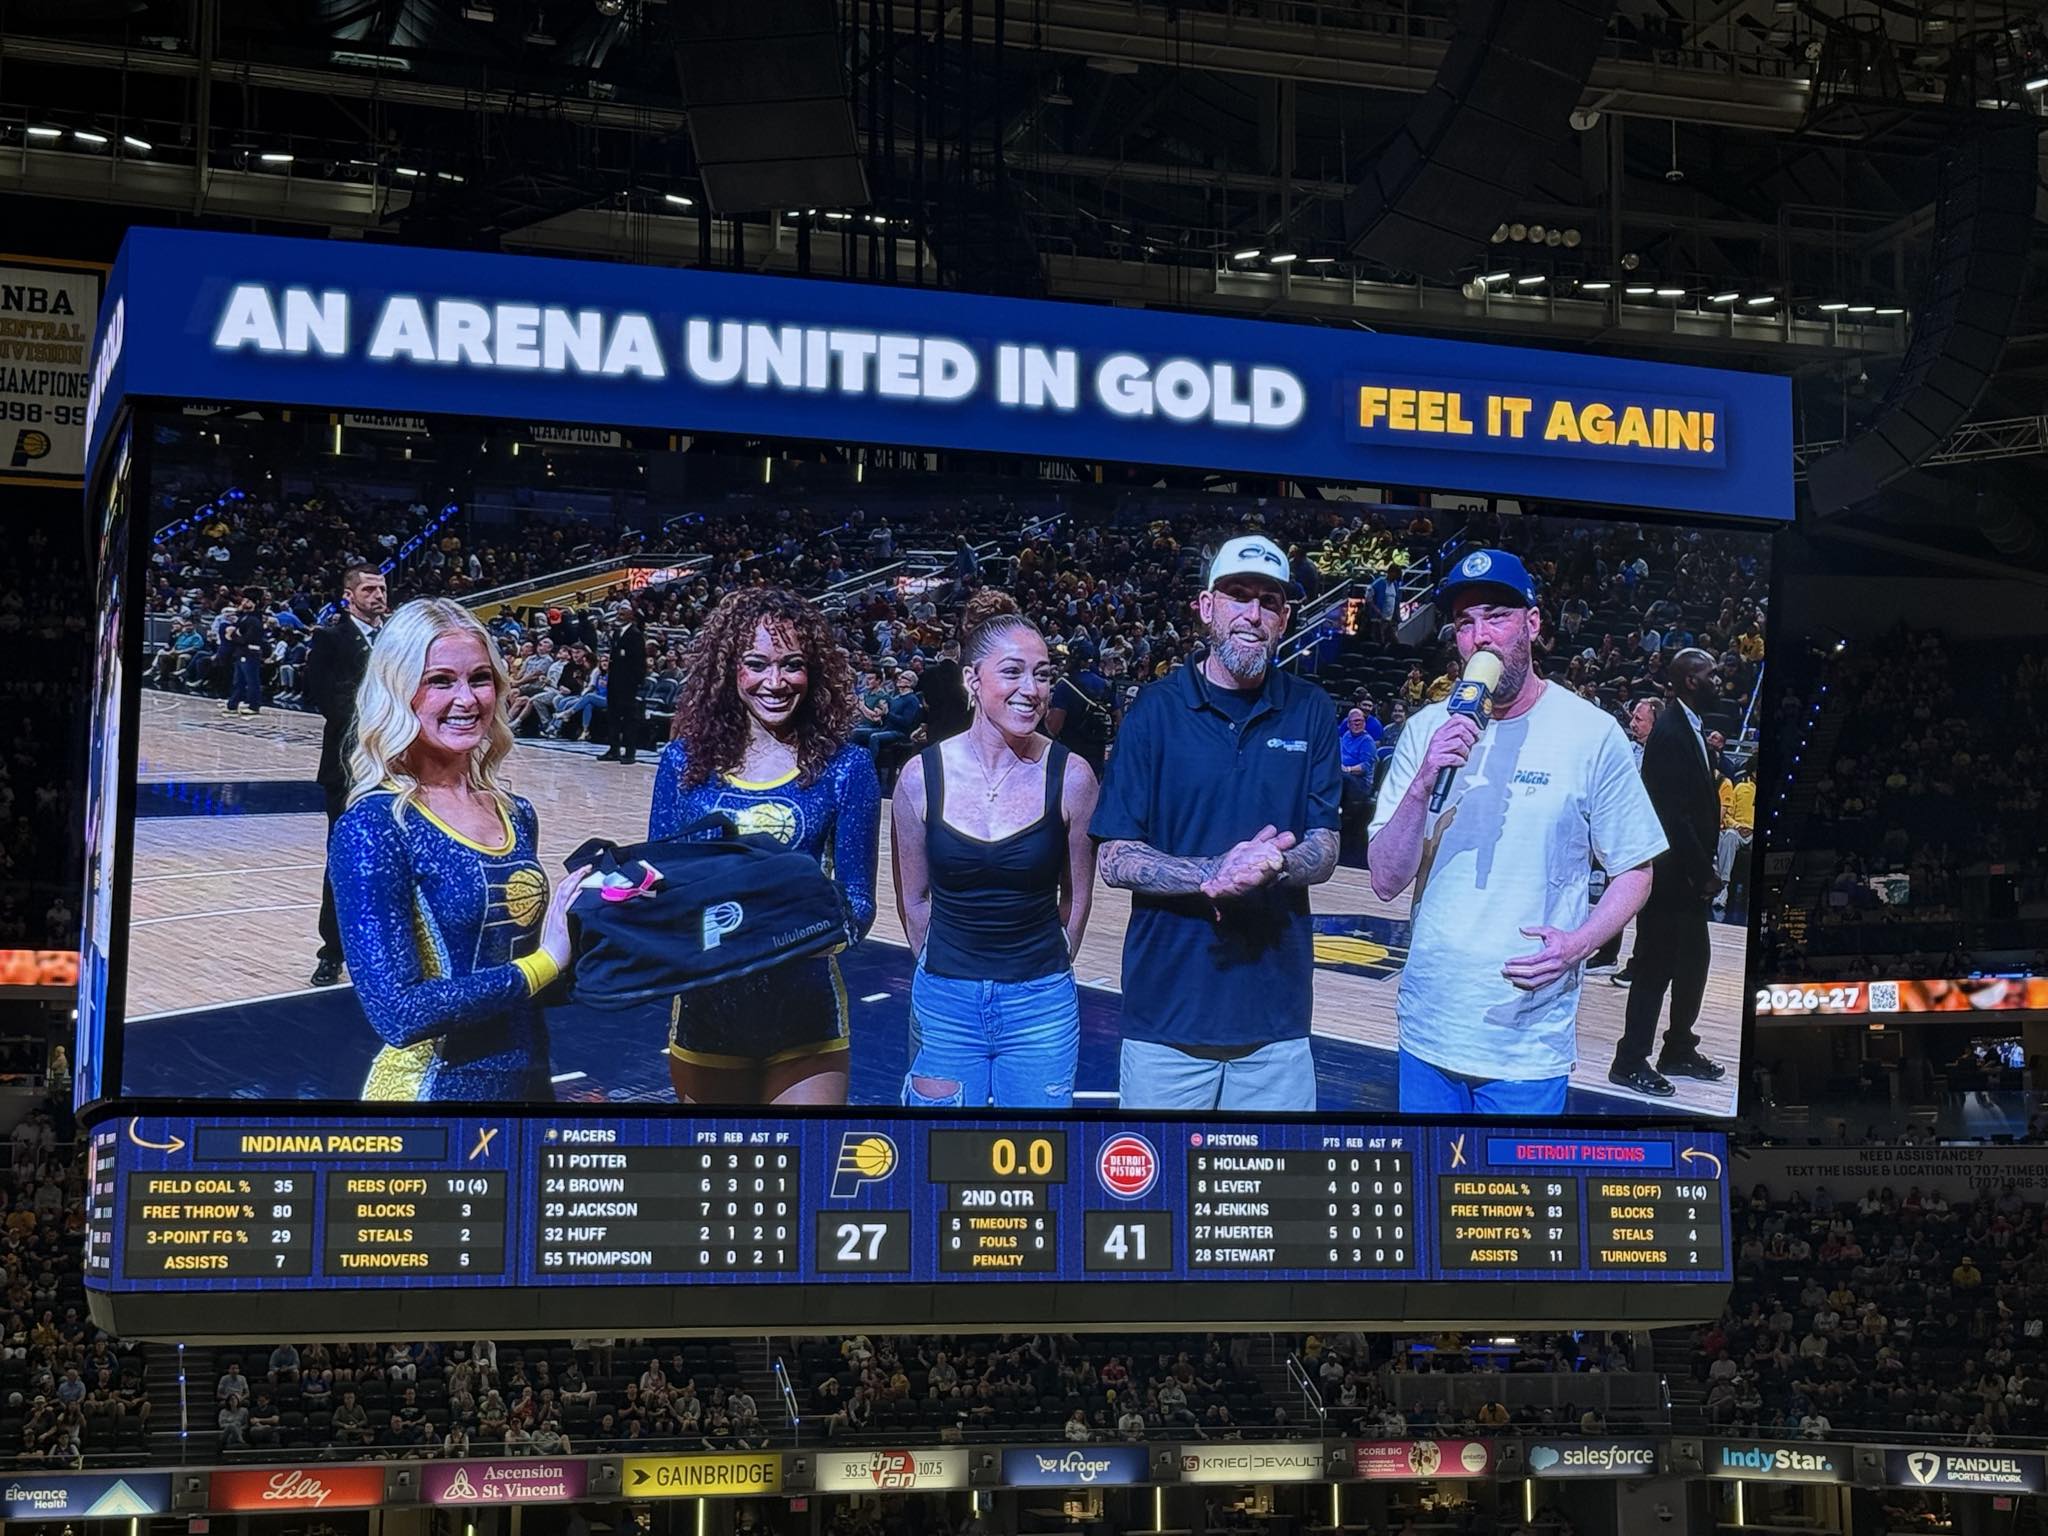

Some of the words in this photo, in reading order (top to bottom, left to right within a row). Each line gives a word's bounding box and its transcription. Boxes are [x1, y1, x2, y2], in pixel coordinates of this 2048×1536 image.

[1, 284, 74, 315] NBA
[0, 317, 86, 342] ENTRAL
[0, 339, 83, 365] IVISION
[215, 285, 347, 354] AN
[369, 296, 666, 376] ARENA
[689, 321, 977, 399] UNITED
[999, 345, 1077, 408] IN
[1099, 354, 1305, 428] GOLD
[0, 366, 88, 399] HAMPIONS
[1359, 386, 1474, 432] FEEL
[1488, 398, 1533, 439] IT
[1543, 402, 1717, 454] AGAIN!
[772, 918, 831, 949] lululemon
[1755, 987, 1860, 1011] 2026-27
[563, 1129, 616, 1142] PACERS
[697, 1132, 717, 1143] PTS
[724, 1132, 743, 1143] REB
[750, 1132, 770, 1143] AST
[776, 1132, 789, 1143] PF
[1207, 1134, 1259, 1147] PISTONS
[1323, 1137, 1340, 1148] PTS
[1346, 1138, 1363, 1148] REB
[1369, 1138, 1386, 1148] AST
[1391, 1139, 1403, 1149] PF
[241, 1135, 323, 1153] INDIANA
[327, 1135, 403, 1153] PACERS
[992, 1138, 1053, 1175] 0.0
[1516, 1145, 1578, 1160] DETROIT
[1581, 1146, 1645, 1161] PISTONS
[1859, 1150, 1893, 1161] NEED
[1895, 1150, 1984, 1161] ASSISTANCE?
[547, 1154, 564, 1168] 11
[569, 1154, 627, 1168] POTTER
[702, 1154, 711, 1168] 0
[728, 1154, 738, 1168] 3
[755, 1154, 764, 1168] 0
[777, 1154, 787, 1168] 0
[1110, 1155, 1146, 1166] DETROIT
[1197, 1157, 1206, 1171] 5
[1214, 1157, 1274, 1171] HOLLAND
[1328, 1159, 1336, 1171] 0
[1350, 1159, 1359, 1171] 0
[1374, 1159, 1381, 1171] 1
[1394, 1159, 1401, 1171] 1
[1110, 1166, 1147, 1177] PISTONS
[1786, 1165, 1815, 1177] TEXT
[1817, 1165, 1840, 1177] THE
[1843, 1165, 1879, 1177] ISSUE
[1893, 1165, 1956, 1176] LOCATION
[1958, 1165, 1972, 1176] TO
[149, 1181, 191, 1194] FIELD
[195, 1180, 235, 1193] GOAL
[238, 1180, 251, 1193] %
[274, 1180, 293, 1193] 35
[347, 1179, 386, 1193] REBS
[389, 1178, 427, 1195] (OFF)
[447, 1179, 465, 1192] 10
[468, 1178, 488, 1195] (4)
[546, 1178, 565, 1193] 24
[569, 1178, 625, 1192] BROWN
[1198, 1180, 1206, 1193] 8
[1214, 1180, 1261, 1193] LEVERT
[1454, 1183, 1485, 1195] FIELD
[1488, 1183, 1519, 1195] GOAL
[1521, 1184, 1531, 1196] %
[1547, 1184, 1562, 1196] 59
[1602, 1184, 1631, 1197] REBS
[1632, 1184, 1661, 1199] (OFF)
[1676, 1186, 1689, 1198] 16
[1692, 1185, 1707, 1200] (4)
[962, 1190, 996, 1206] 2ND
[1000, 1190, 1034, 1207] QTR
[143, 1205, 180, 1219] FREE
[183, 1205, 240, 1219] THROW
[242, 1205, 255, 1218] %
[273, 1205, 292, 1218] 80
[357, 1204, 416, 1218] BLOCKS
[462, 1204, 472, 1217] 3
[545, 1203, 564, 1217] 29
[568, 1203, 638, 1217] JACKSON
[1194, 1203, 1211, 1216] 24
[1214, 1203, 1269, 1216] JENKINS
[1451, 1205, 1479, 1217] FREE
[1482, 1206, 1524, 1218] THROW
[1526, 1207, 1535, 1218] %
[1548, 1206, 1562, 1218] 83
[1611, 1207, 1654, 1219] BLOCKS
[1688, 1208, 1696, 1220] 2
[952, 1218, 961, 1230] 5
[968, 1217, 1028, 1230] TIMEOUTS
[1035, 1218, 1044, 1230] 6
[147, 1231, 210, 1244] 3-POINT
[213, 1230, 233, 1244] FG
[236, 1230, 248, 1243] %
[271, 1230, 291, 1243] 29
[357, 1229, 414, 1242] STEALS
[460, 1229, 470, 1242] 2
[544, 1227, 563, 1241] 32
[568, 1227, 607, 1241] HUFF
[1194, 1226, 1211, 1239] 27
[1214, 1226, 1273, 1239] HUERTER
[1456, 1228, 1502, 1240] 3-POINT
[1505, 1228, 1521, 1240] FG
[1522, 1228, 1531, 1240] %
[1548, 1228, 1563, 1240] 57
[1612, 1229, 1654, 1241] STEALS
[1689, 1230, 1697, 1242] 4
[836, 1223, 887, 1261] 27
[952, 1236, 961, 1249] 0
[979, 1236, 1017, 1248] FOULS
[1035, 1236, 1044, 1249] 0
[1103, 1224, 1147, 1260] 41
[164, 1256, 229, 1270] ASSISTS
[275, 1255, 285, 1268] 7
[340, 1254, 429, 1267] TURNOVERS
[460, 1253, 470, 1266] 5
[544, 1252, 563, 1266] 55
[567, 1251, 652, 1266] THOMPSON
[973, 1254, 1023, 1267] PENALTY
[1195, 1249, 1212, 1262] 28
[1215, 1249, 1275, 1262] STEWART
[1470, 1250, 1518, 1262] ASSISTS
[1549, 1250, 1563, 1262] 11
[1601, 1250, 1667, 1263] TURNOVERS
[1689, 1252, 1698, 1263] 2
[1358, 1447, 1386, 1456] SCORE
[1387, 1447, 1403, 1456] BIG
[1563, 1445, 1655, 1470] salesforce
[869, 1452, 906, 1471] the
[918, 1461, 943, 1476] 107.5
[1059, 1451, 1110, 1482] Kroger
[1203, 1457, 1248, 1469] KRIEG
[1946, 1456, 2022, 1473] FANDUEL
[483, 1465, 564, 1481] Ascension
[656, 1464, 774, 1486] GAINBRIDGE
[845, 1463, 867, 1479] 93.5
[1947, 1472, 1979, 1482] SPORTS
[1981, 1473, 2023, 1483] NETWORK
[877, 1469, 916, 1488] fan
[5, 1485, 68, 1501] Elevance
[262, 1470, 334, 1508] Lilly
[482, 1483, 504, 1498] St.
[506, 1482, 566, 1498] Vincent
[34, 1499, 67, 1510] Health
